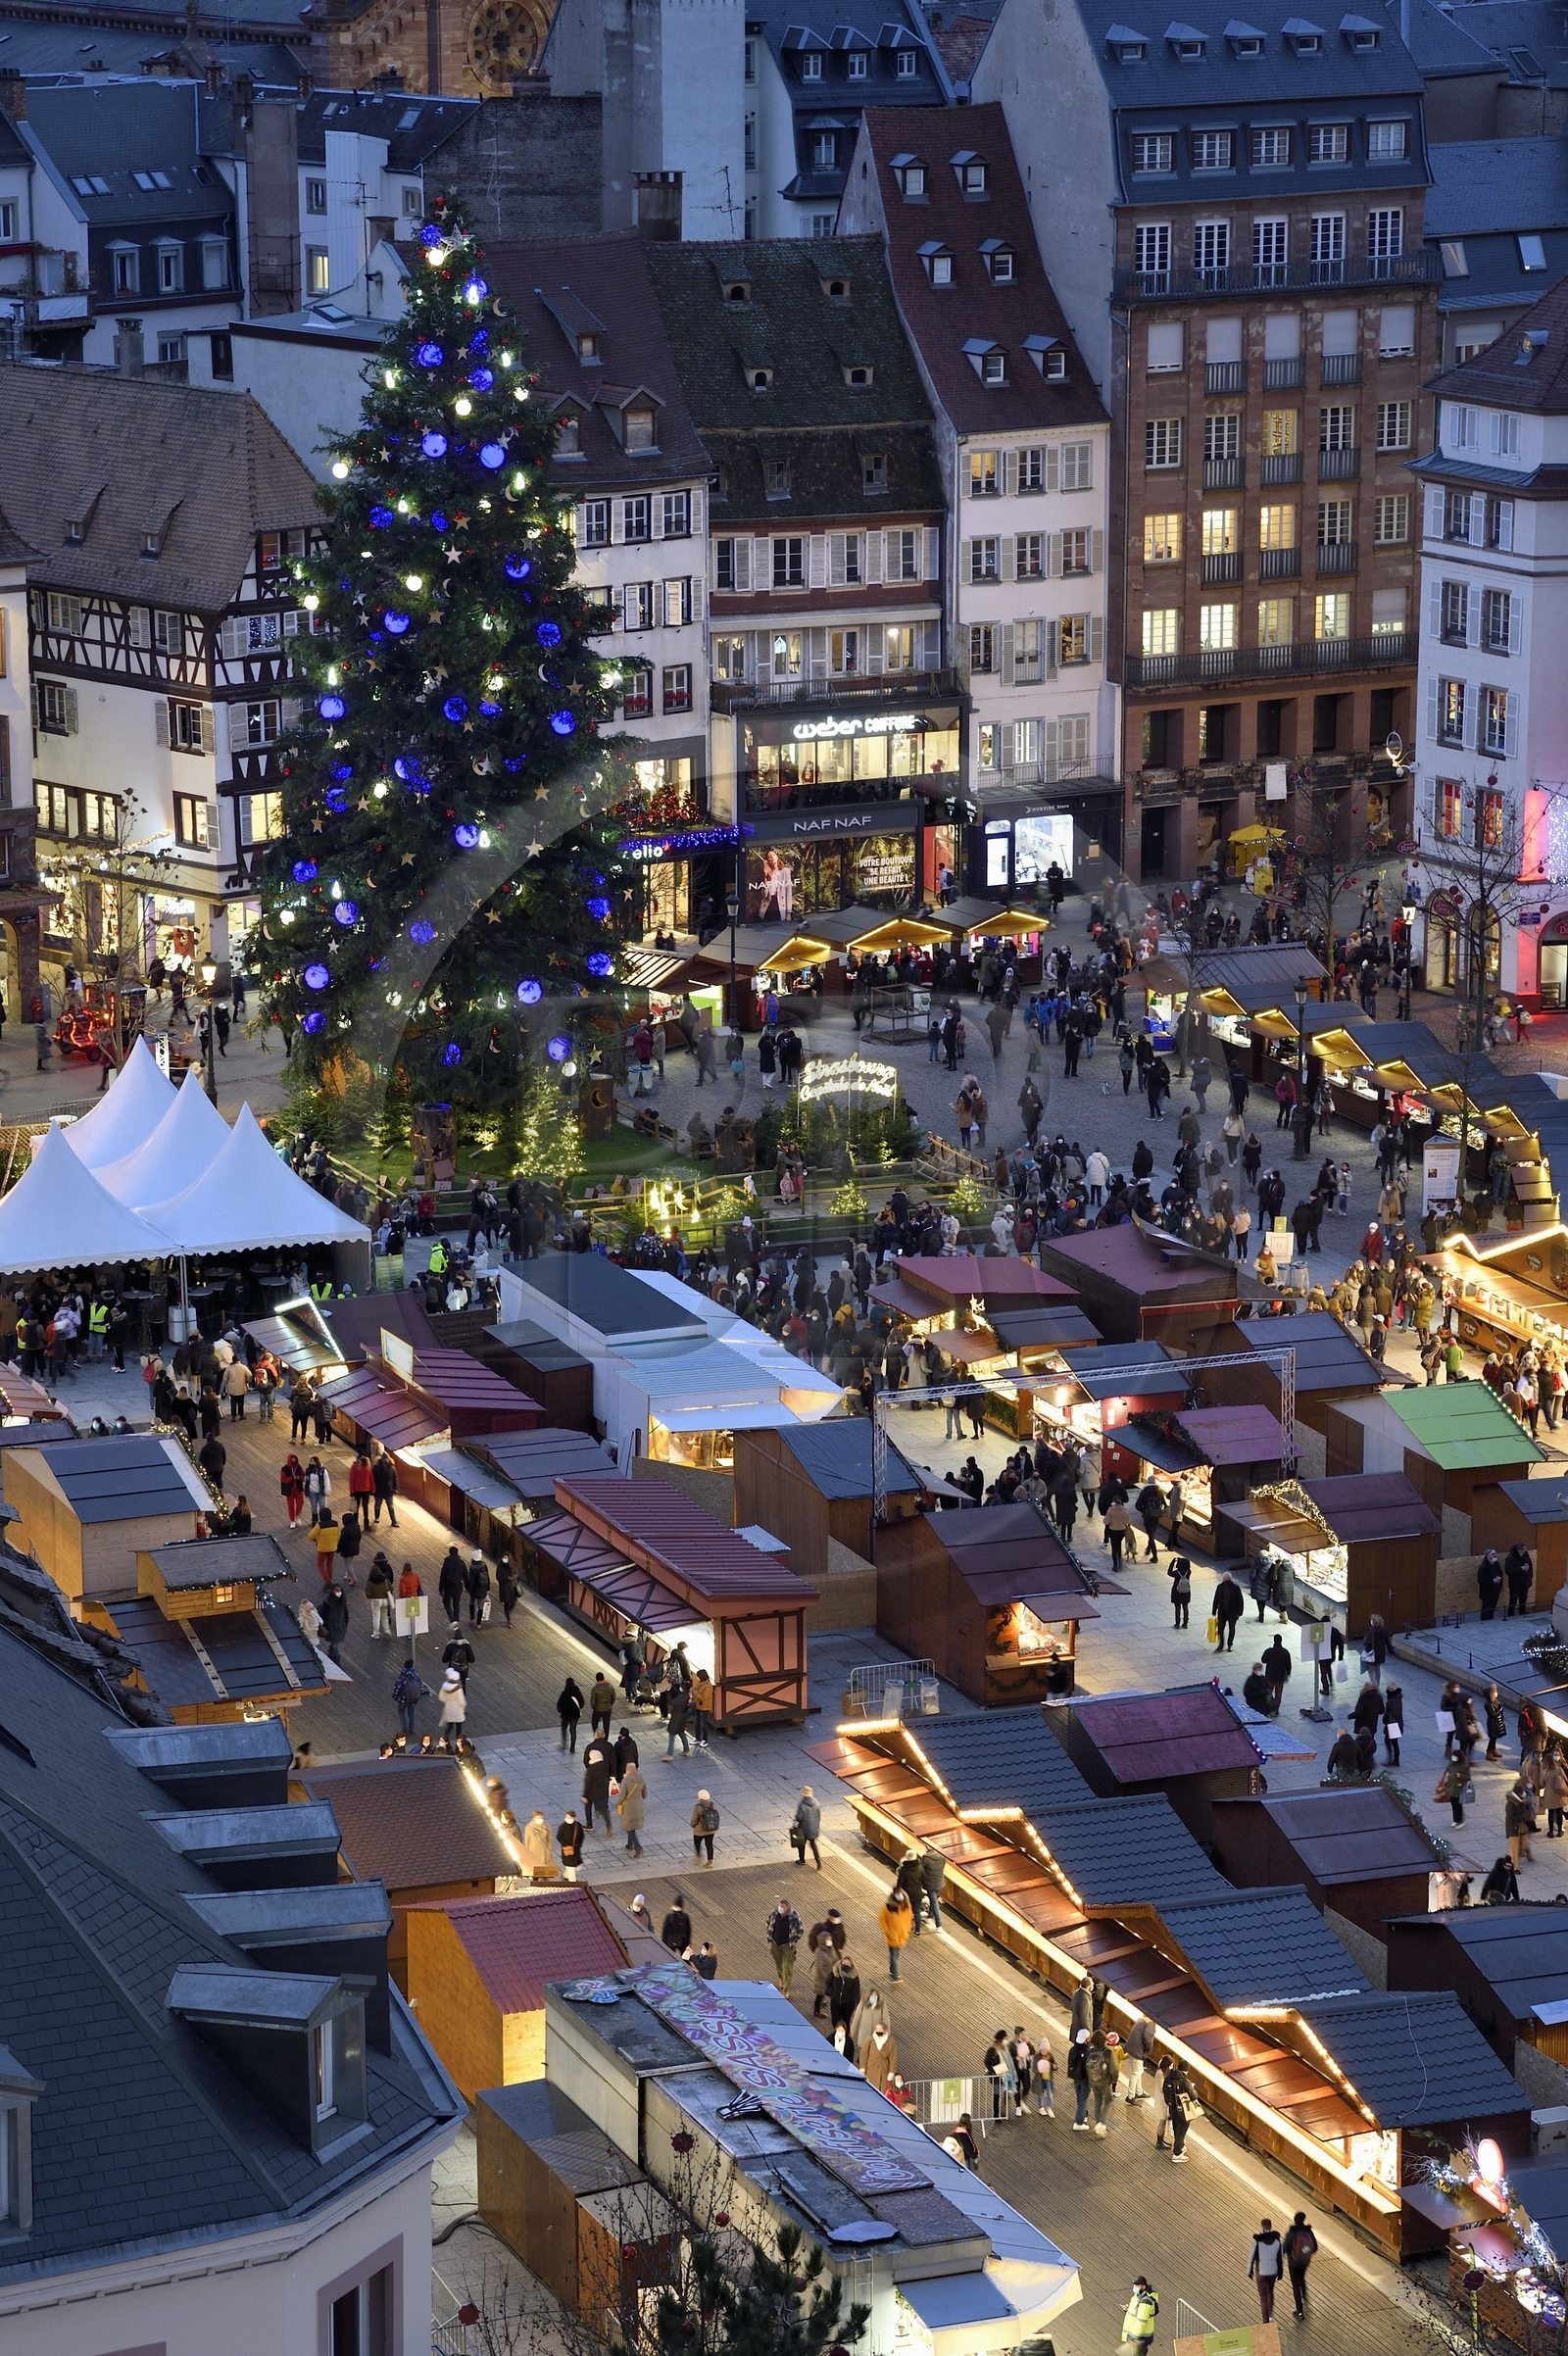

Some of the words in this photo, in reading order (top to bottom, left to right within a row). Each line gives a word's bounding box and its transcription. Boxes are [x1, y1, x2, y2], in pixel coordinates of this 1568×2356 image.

[864, 714, 915, 733] COIFFURE
[794, 819, 831, 832] NAF
[834, 815, 872, 828] NAF
[859, 858, 880, 867] VOTRE
[880, 856, 914, 866] BOUTIQUE
[869, 867, 879, 876] SE
[879, 865, 902, 875] REFAIT
[863, 876, 878, 886] UNE
[878, 872, 905, 884] BEAUTÉ
[803, 1053, 897, 1084] Strasbourg
[800, 1075, 850, 1102] Capitale
[850, 1075, 865, 1091] de
[697, 2007, 788, 2089] SASSI
